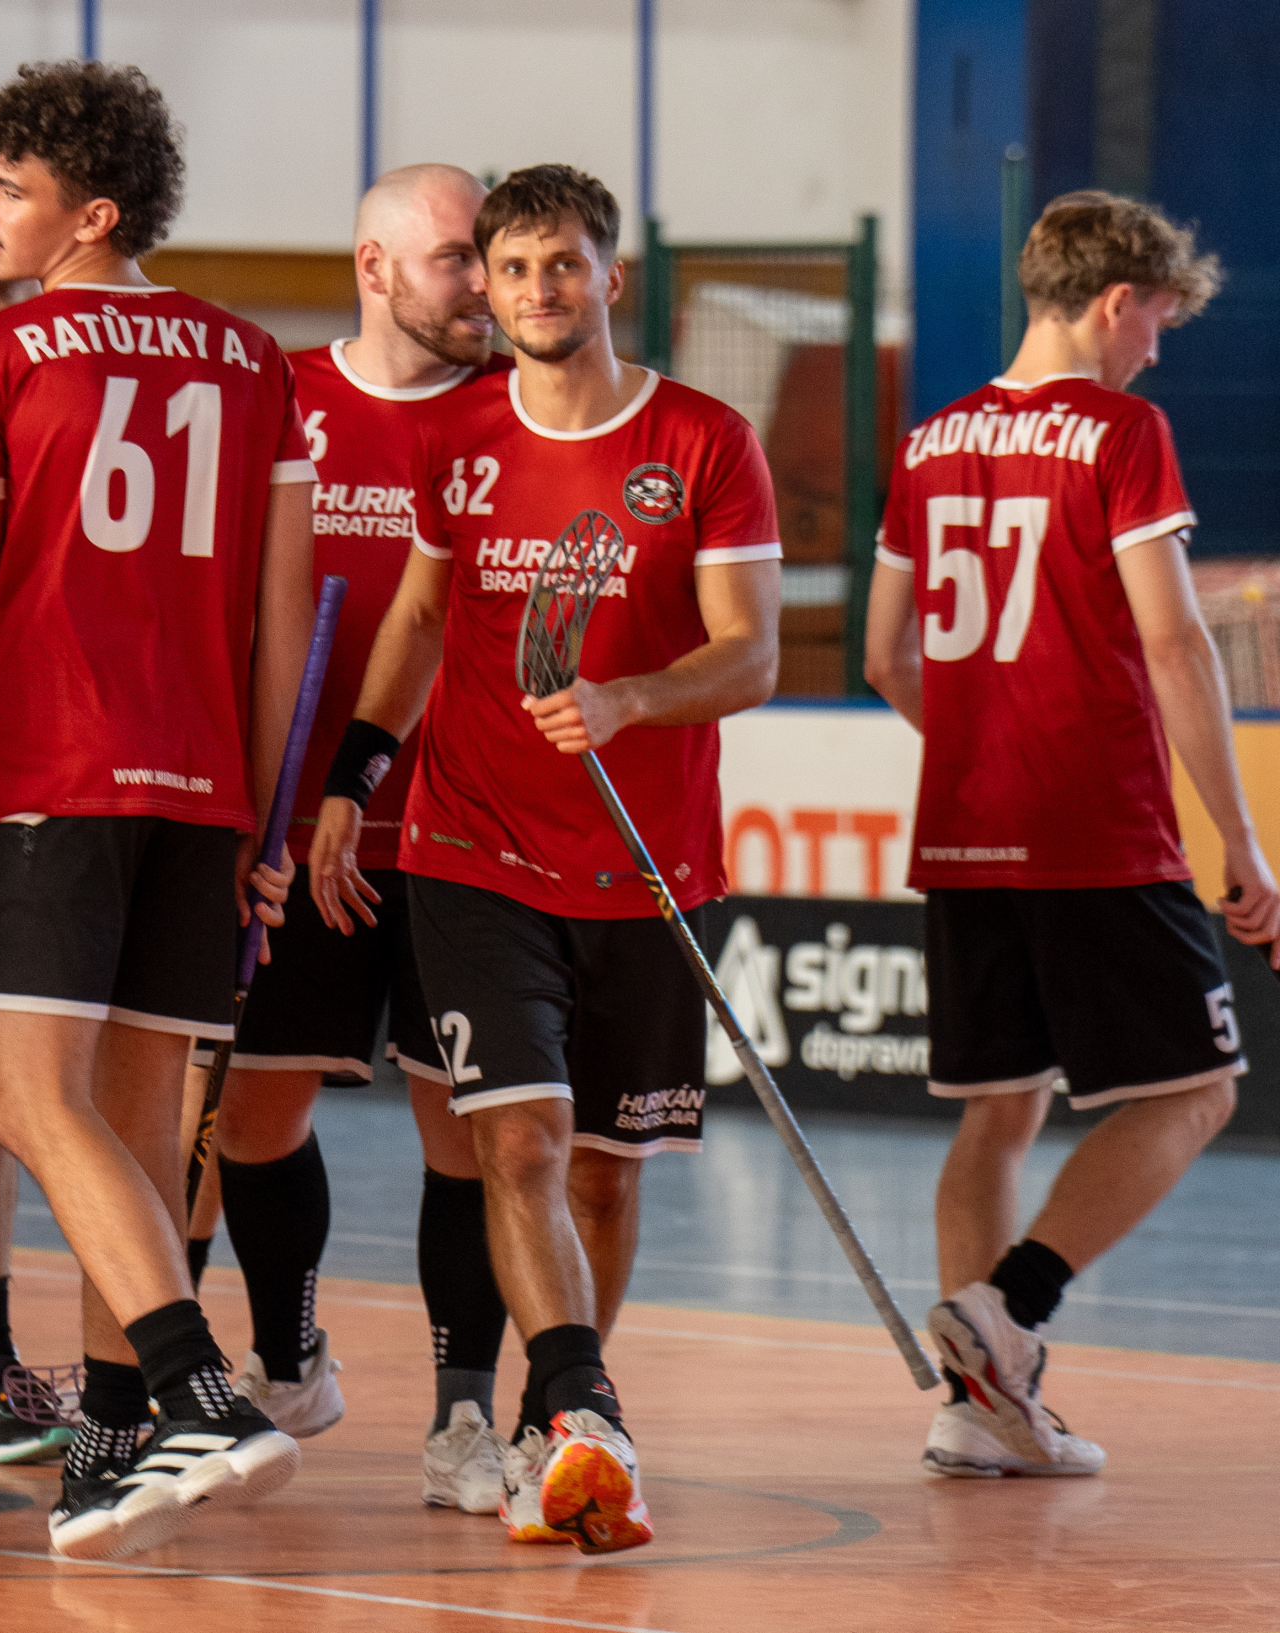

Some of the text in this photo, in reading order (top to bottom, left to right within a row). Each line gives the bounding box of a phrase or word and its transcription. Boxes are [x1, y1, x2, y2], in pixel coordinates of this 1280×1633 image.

[13, 304, 260, 374] RATŮZKY A.
[81, 375, 222, 559] 61
[311, 483, 416, 515] HURIK
[313, 513, 415, 538] BRATISL
[923, 495, 1050, 663] 57
[784, 922, 929, 1033] sign
[430, 1010, 483, 1088] 2
